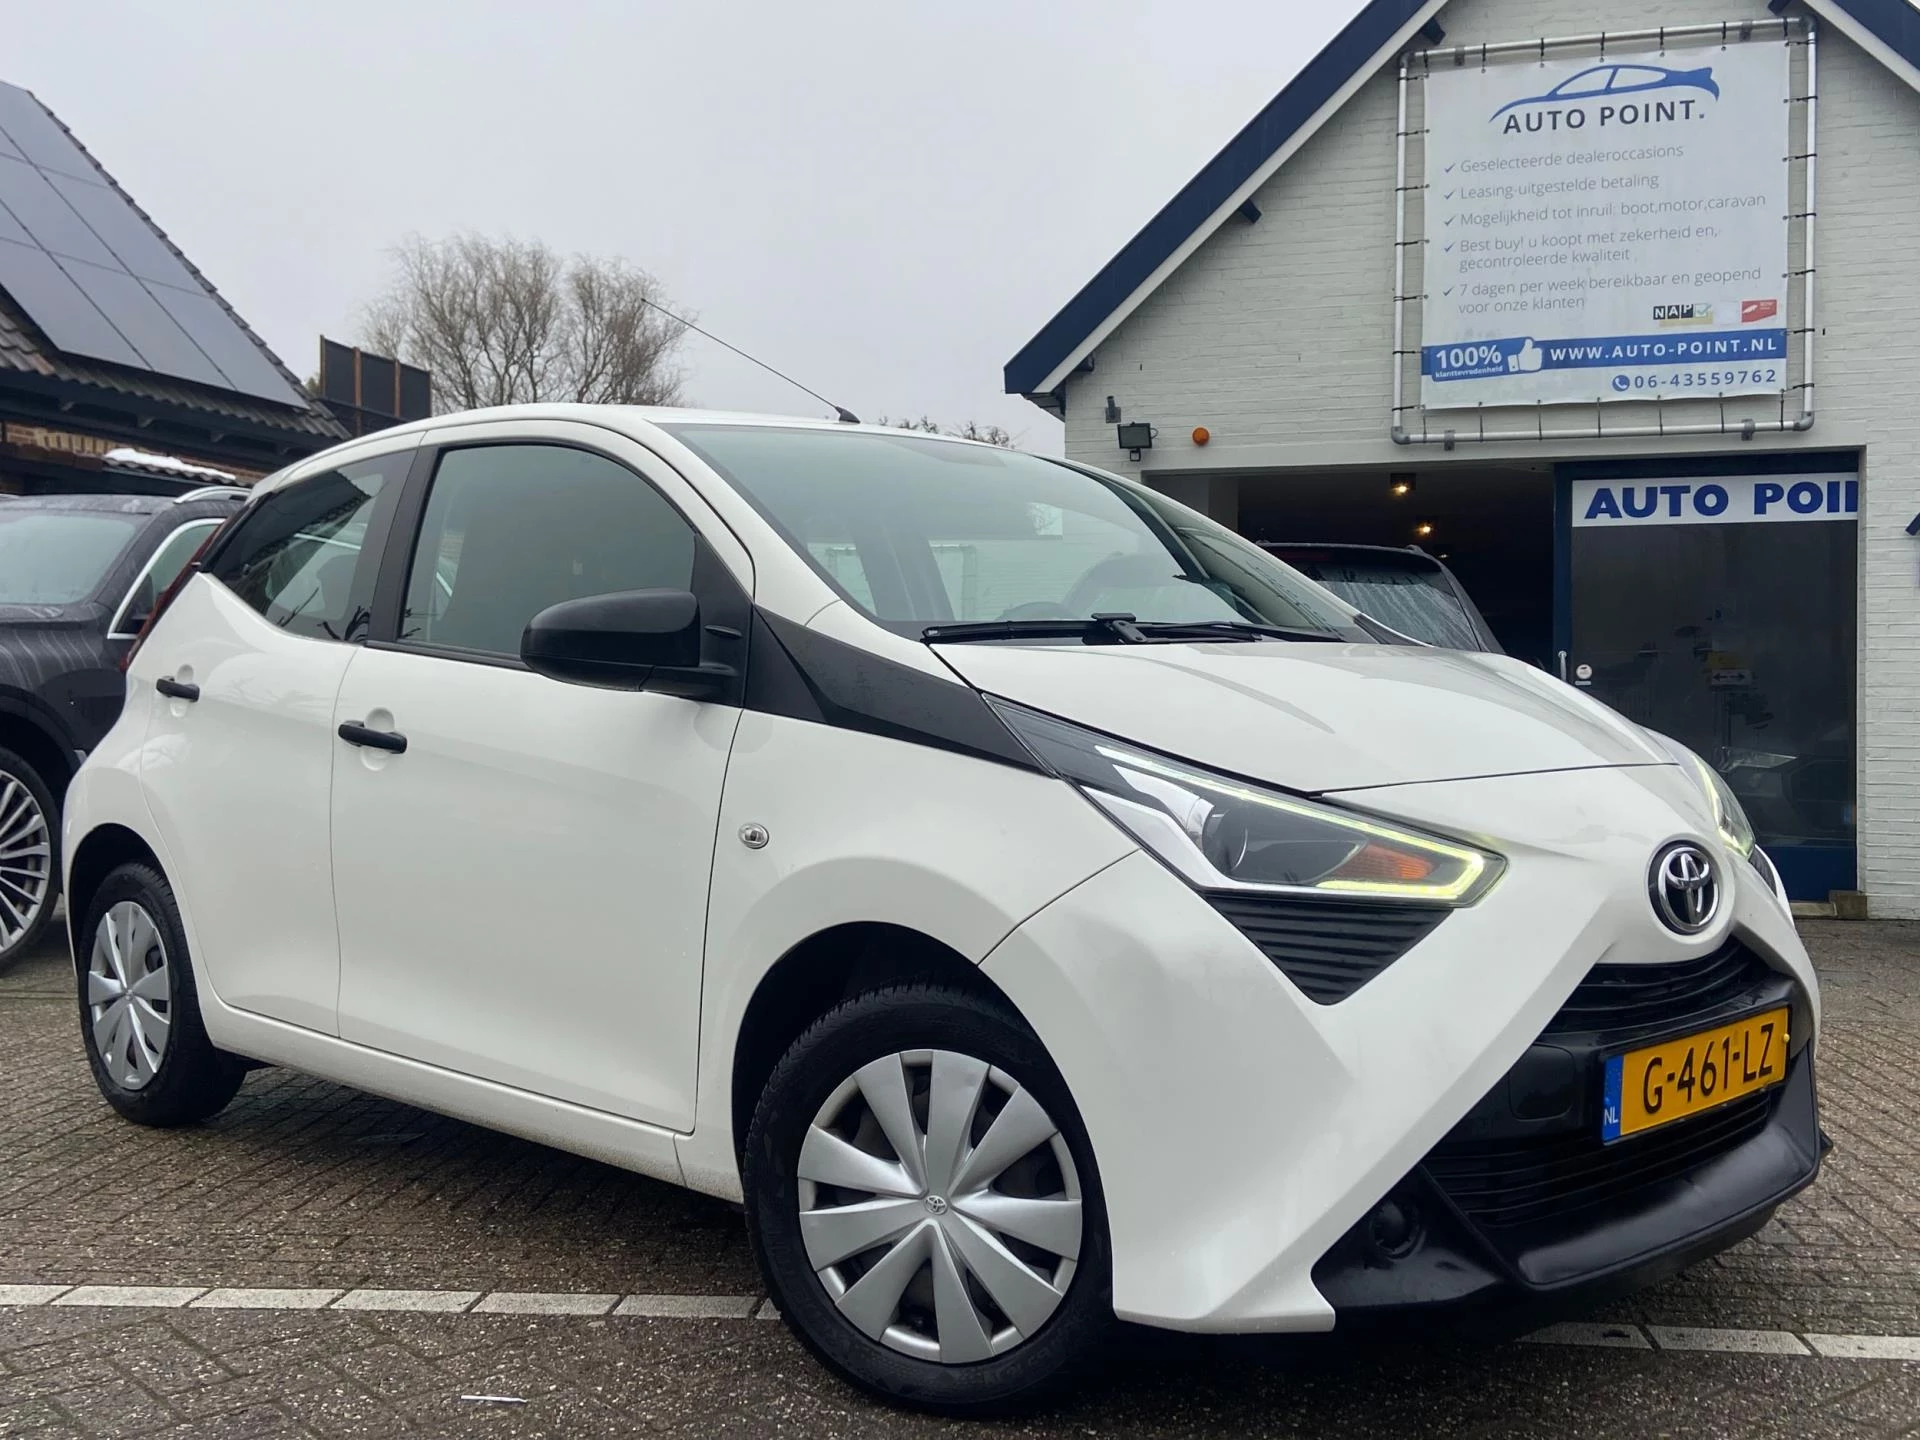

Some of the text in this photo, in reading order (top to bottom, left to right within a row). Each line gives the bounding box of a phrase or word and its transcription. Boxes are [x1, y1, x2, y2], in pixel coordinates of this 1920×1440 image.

[1503, 108, 1586, 135] AUTO
[1460, 145, 1684, 173] Geselecteerde dealeroccasions
[1601, 175, 1660, 190] betaling
[1460, 207, 1548, 227] Mogelijkheid
[1552, 207, 1572, 220] tot
[1460, 240, 1491, 252] Best
[1495, 236, 1524, 252] buy!
[1528, 238, 1537, 248] u
[1542, 235, 1582, 251] koopt
[1587, 231, 1615, 244] met
[1619, 225, 1691, 242] zekerheid
[1459, 248, 1630, 273] gecontroleerde kwaliteit
[1460, 267, 1761, 298] 7 dagen per week bereikbaar en geopend
[1458, 296, 1585, 314] voor onze klanten
[1653, 304, 1694, 320] NAP
[1436, 344, 1502, 369] 100%
[1550, 338, 1777, 361] WWW.AUTO-POINT.NL
[1634, 369, 1776, 389] 06-43559762
[1584, 484, 1729, 519] AUTO
[1643, 1023, 1774, 1115] G-461-LZ
[1604, 1106, 1619, 1126] NL
